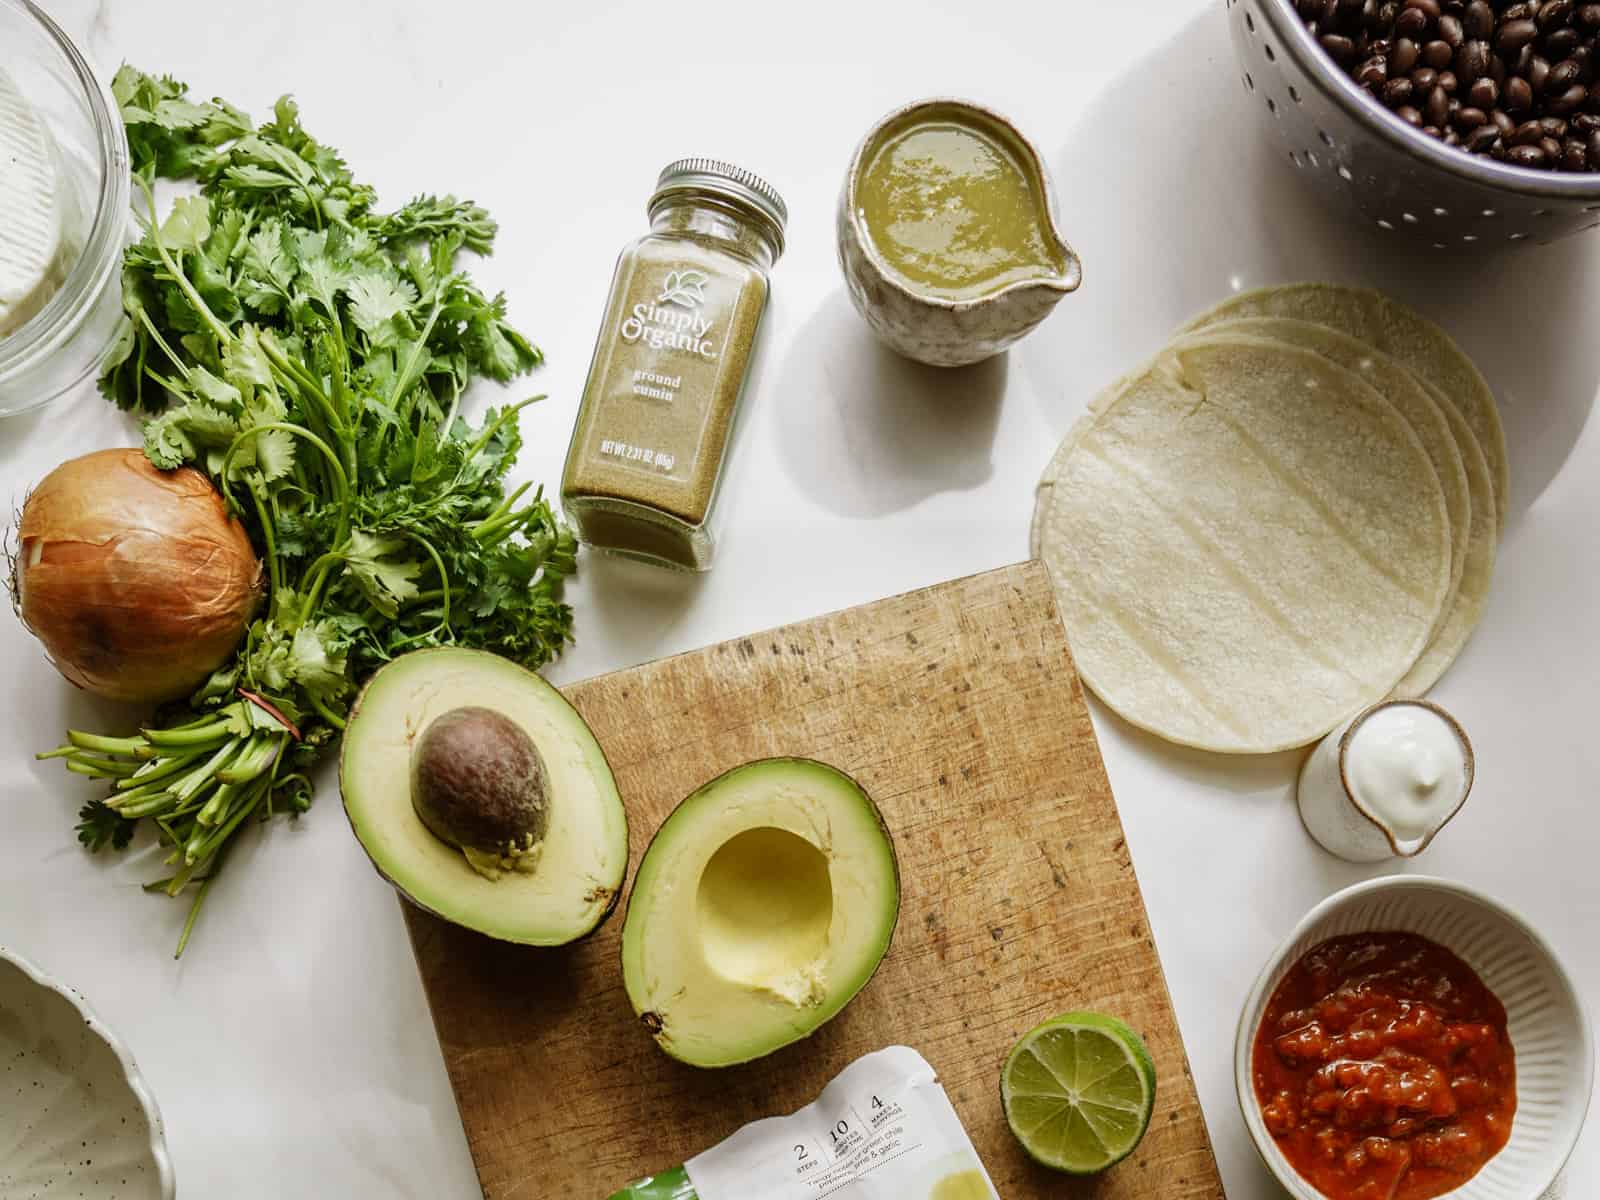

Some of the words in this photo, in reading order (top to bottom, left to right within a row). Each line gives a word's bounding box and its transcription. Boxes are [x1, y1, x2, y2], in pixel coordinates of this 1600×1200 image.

[633, 302, 714, 338] Simply
[633, 369, 681, 389] ground
[633, 383, 673, 402] cumin
[871, 1095, 883, 1109] 4
[829, 1120, 849, 1143] 10
[793, 1144, 808, 1161] 2
